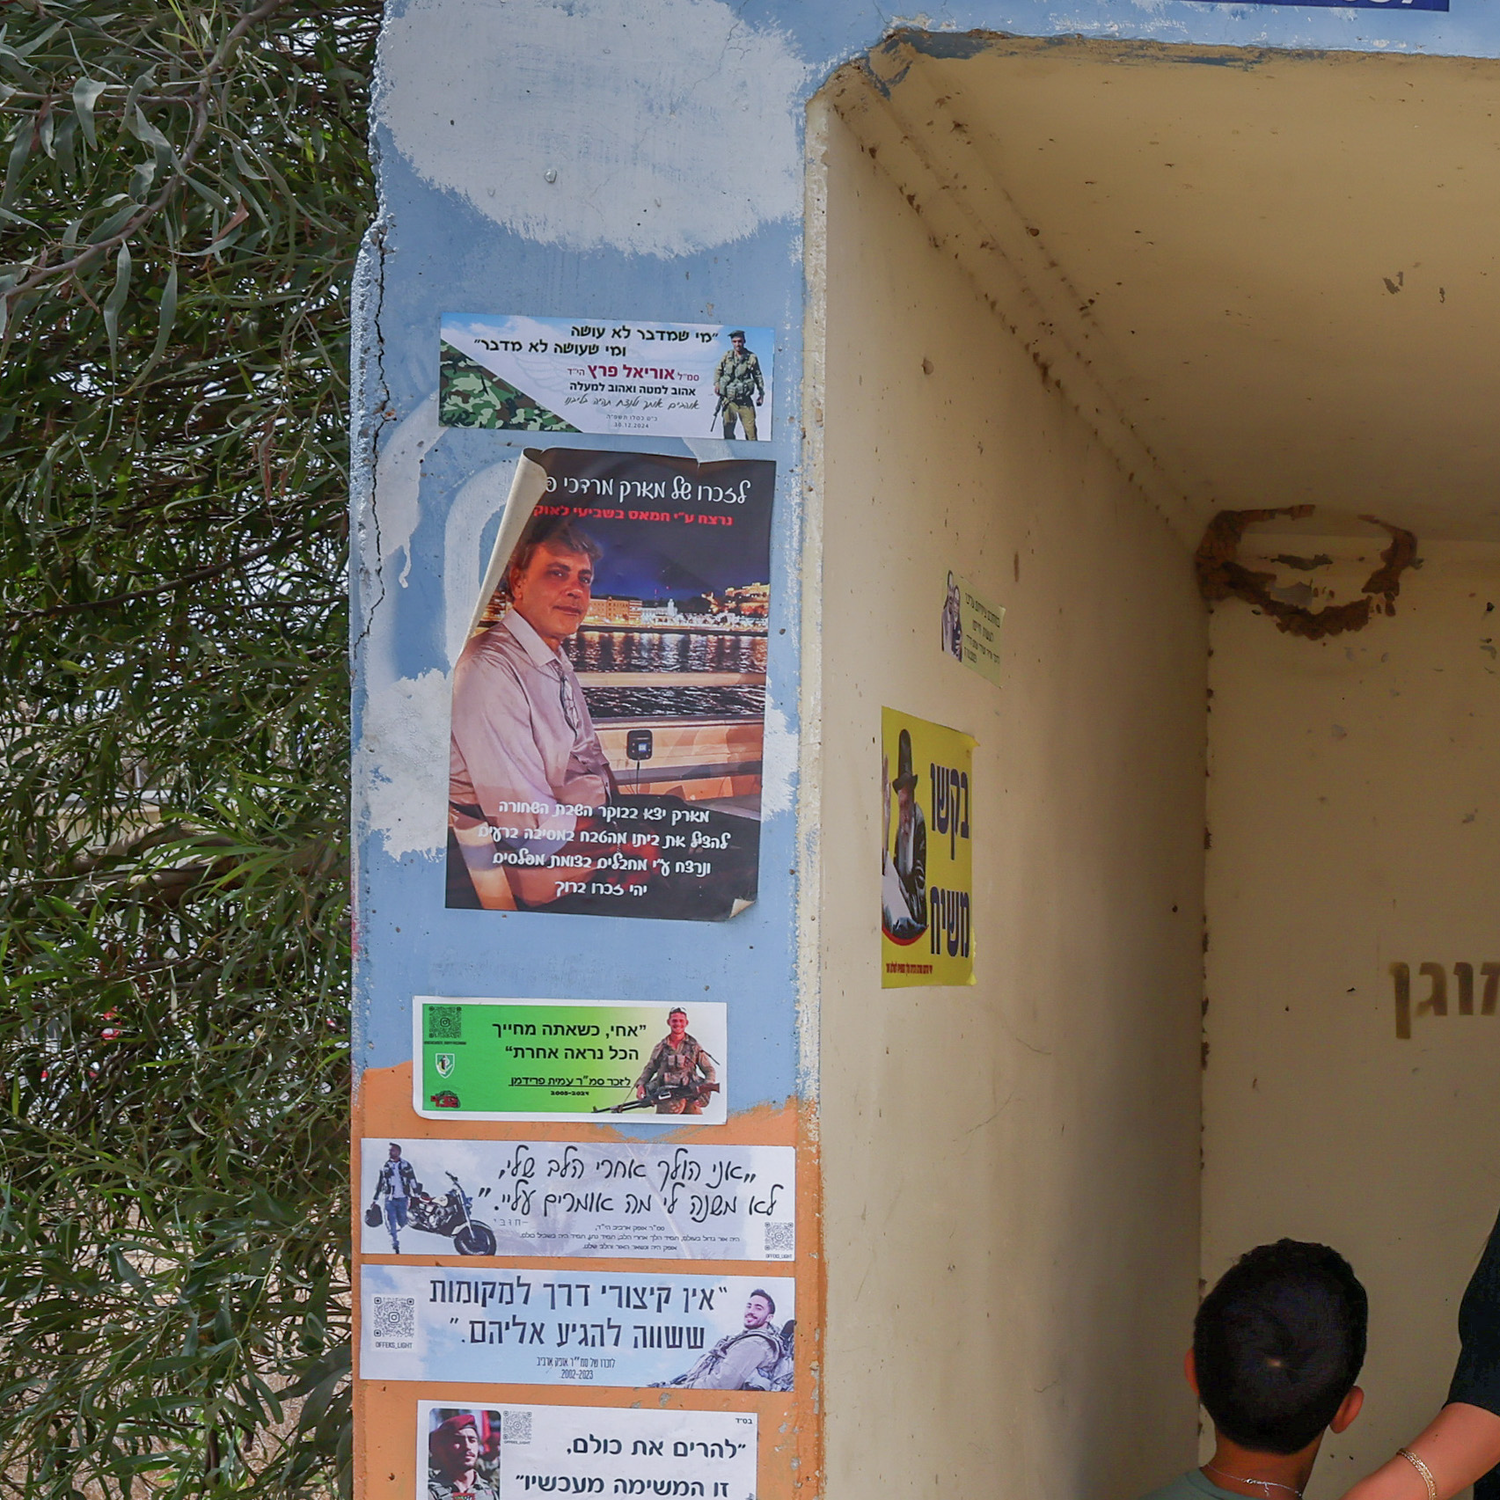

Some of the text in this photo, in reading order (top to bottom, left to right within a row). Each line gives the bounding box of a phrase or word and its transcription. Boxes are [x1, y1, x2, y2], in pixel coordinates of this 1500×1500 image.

[571, 326, 718, 343] "מי שמדבר לא עושה
[474, 338, 626, 357] ומי שעושה לא מדבר"
[588, 364, 675, 380] אוריאל פרץ
[563, 477, 614, 496] מרדכי
[619, 480, 665, 503] מארק
[671, 476, 691, 500] של
[698, 480, 751, 504] לזכרו
[930, 761, 970, 861] בקשו
[554, 881, 647, 897] יהי זכרו ברוך
[929, 884, 971, 960] משיח
[492, 1023, 647, 1040] "אחי, כשאתה מחייך
[505, 1046, 639, 1060] הכל נראה אחרת"
[498, 1145, 701, 1192] הולך אחרי הלב שלי,
[544, 1180, 785, 1222] לא משנה לי מה אומרים
[429, 1275, 727, 1313] "אין קיצורי דרך למקומות
[556, 1317, 705, 1350] ששווה להגיע
[561, 1369, 594, 1379] 2002-2023
[567, 1435, 746, 1458] "להרים את כולם,
[515, 1473, 729, 1498] זו המשימה מעכשיו"
